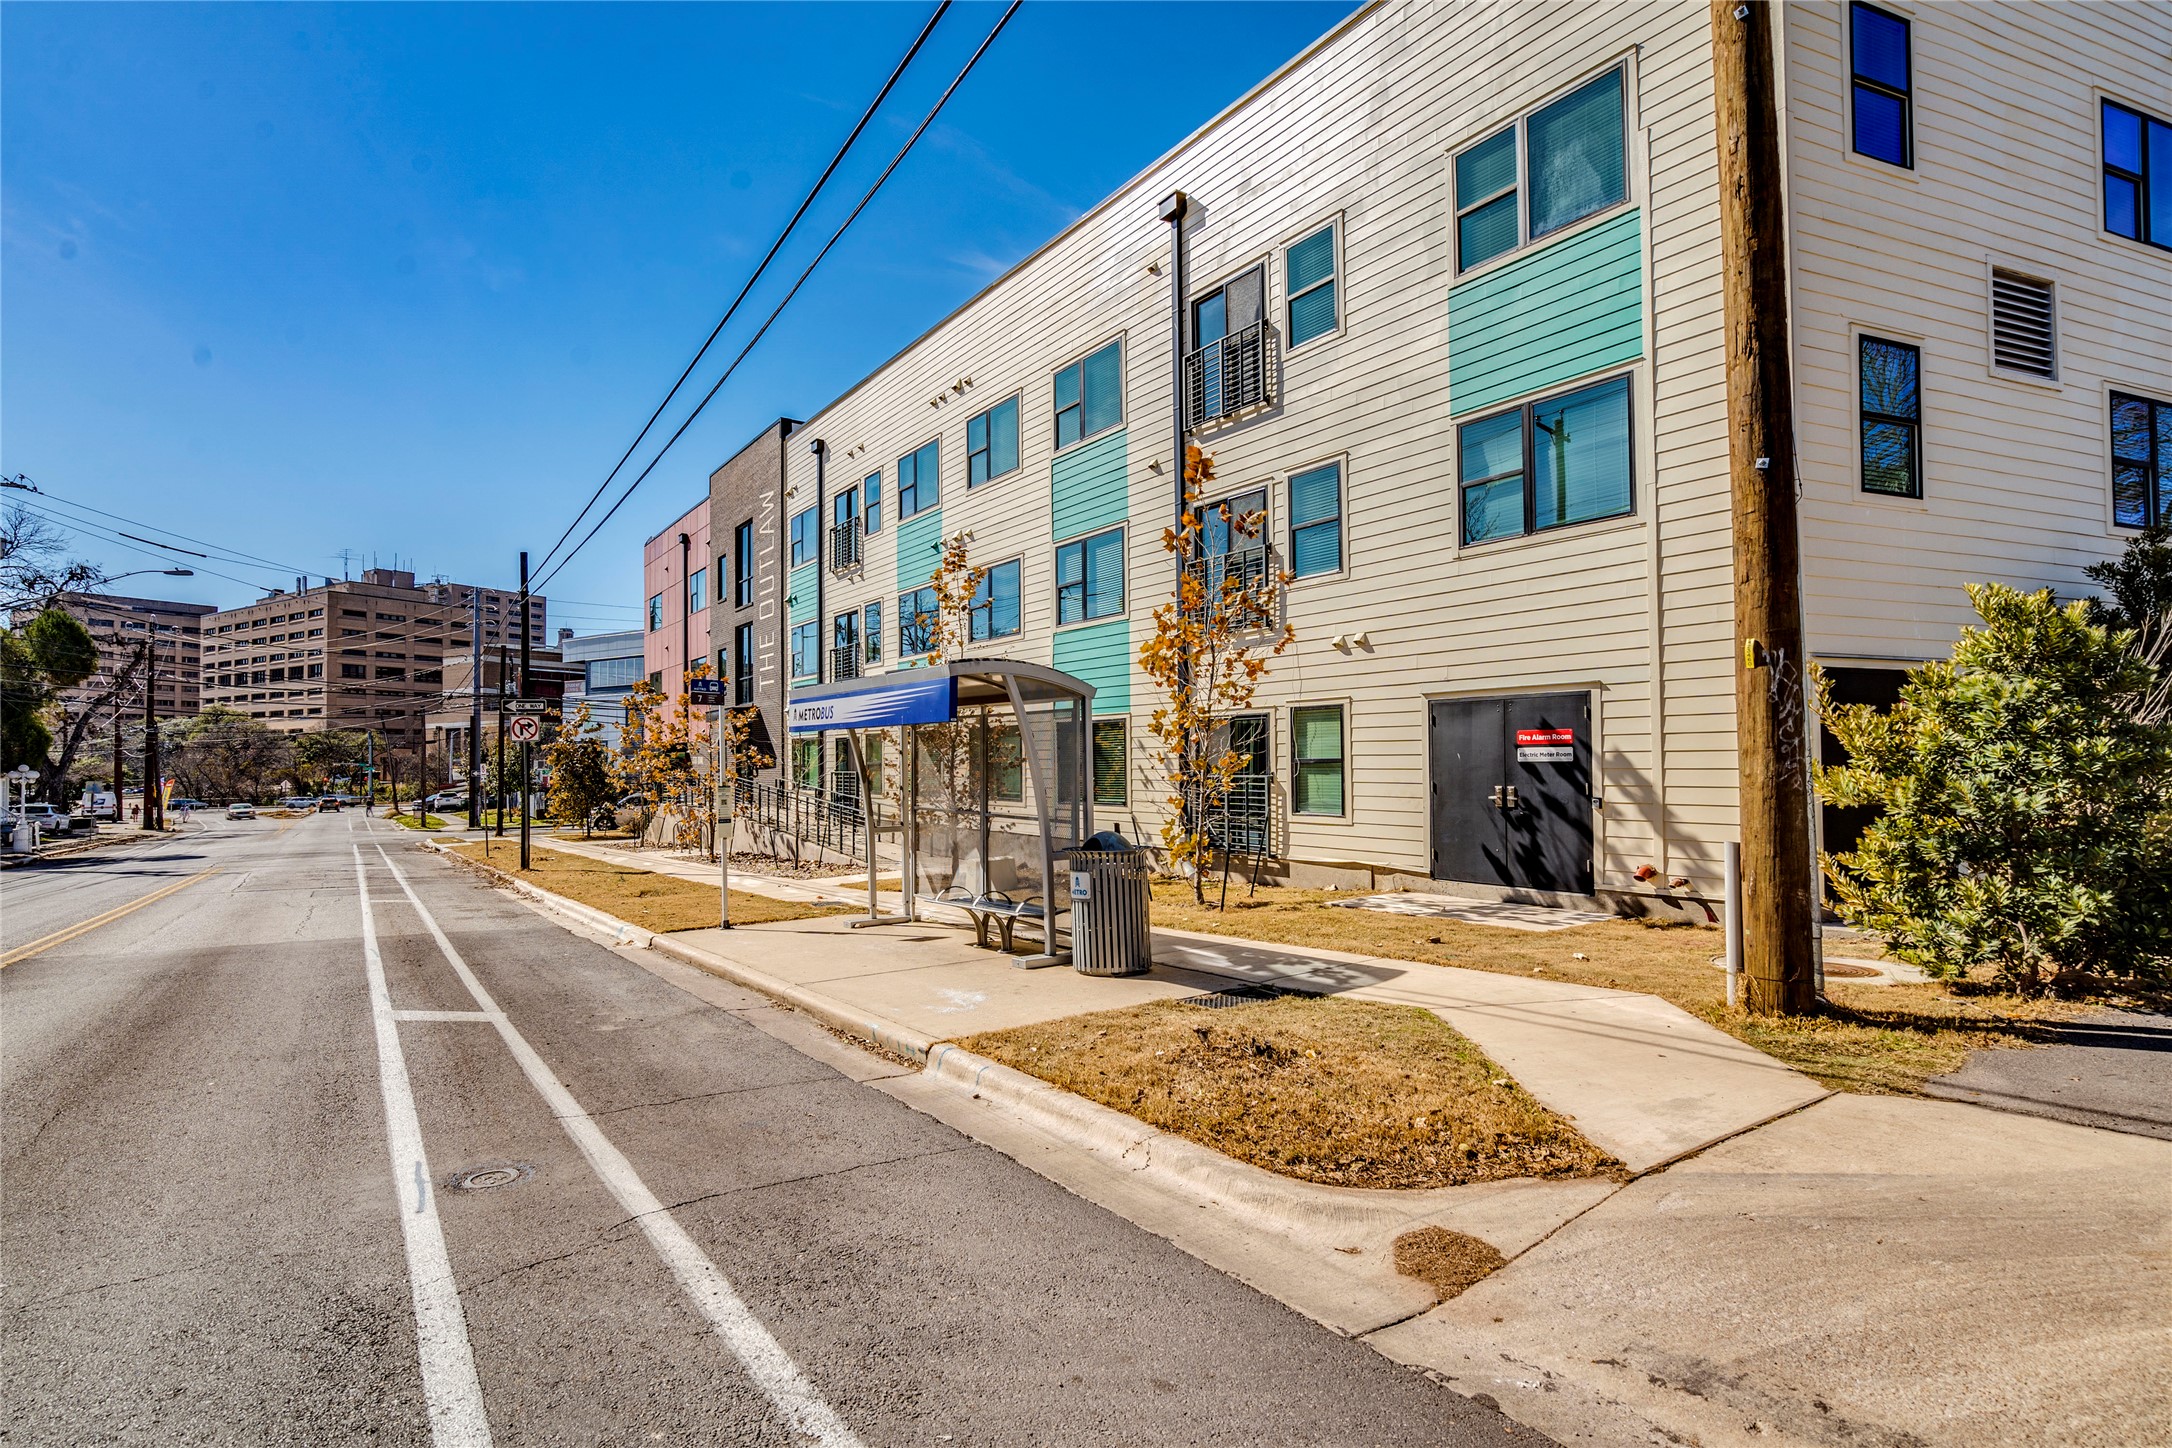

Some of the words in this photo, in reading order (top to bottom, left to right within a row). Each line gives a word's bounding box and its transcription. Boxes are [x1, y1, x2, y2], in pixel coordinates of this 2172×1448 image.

[759, 490, 775, 620] OUTLAW
[759, 630, 775, 692] THE
[697, 694, 703, 702] 7
[798, 705, 834, 721] METROBUS
